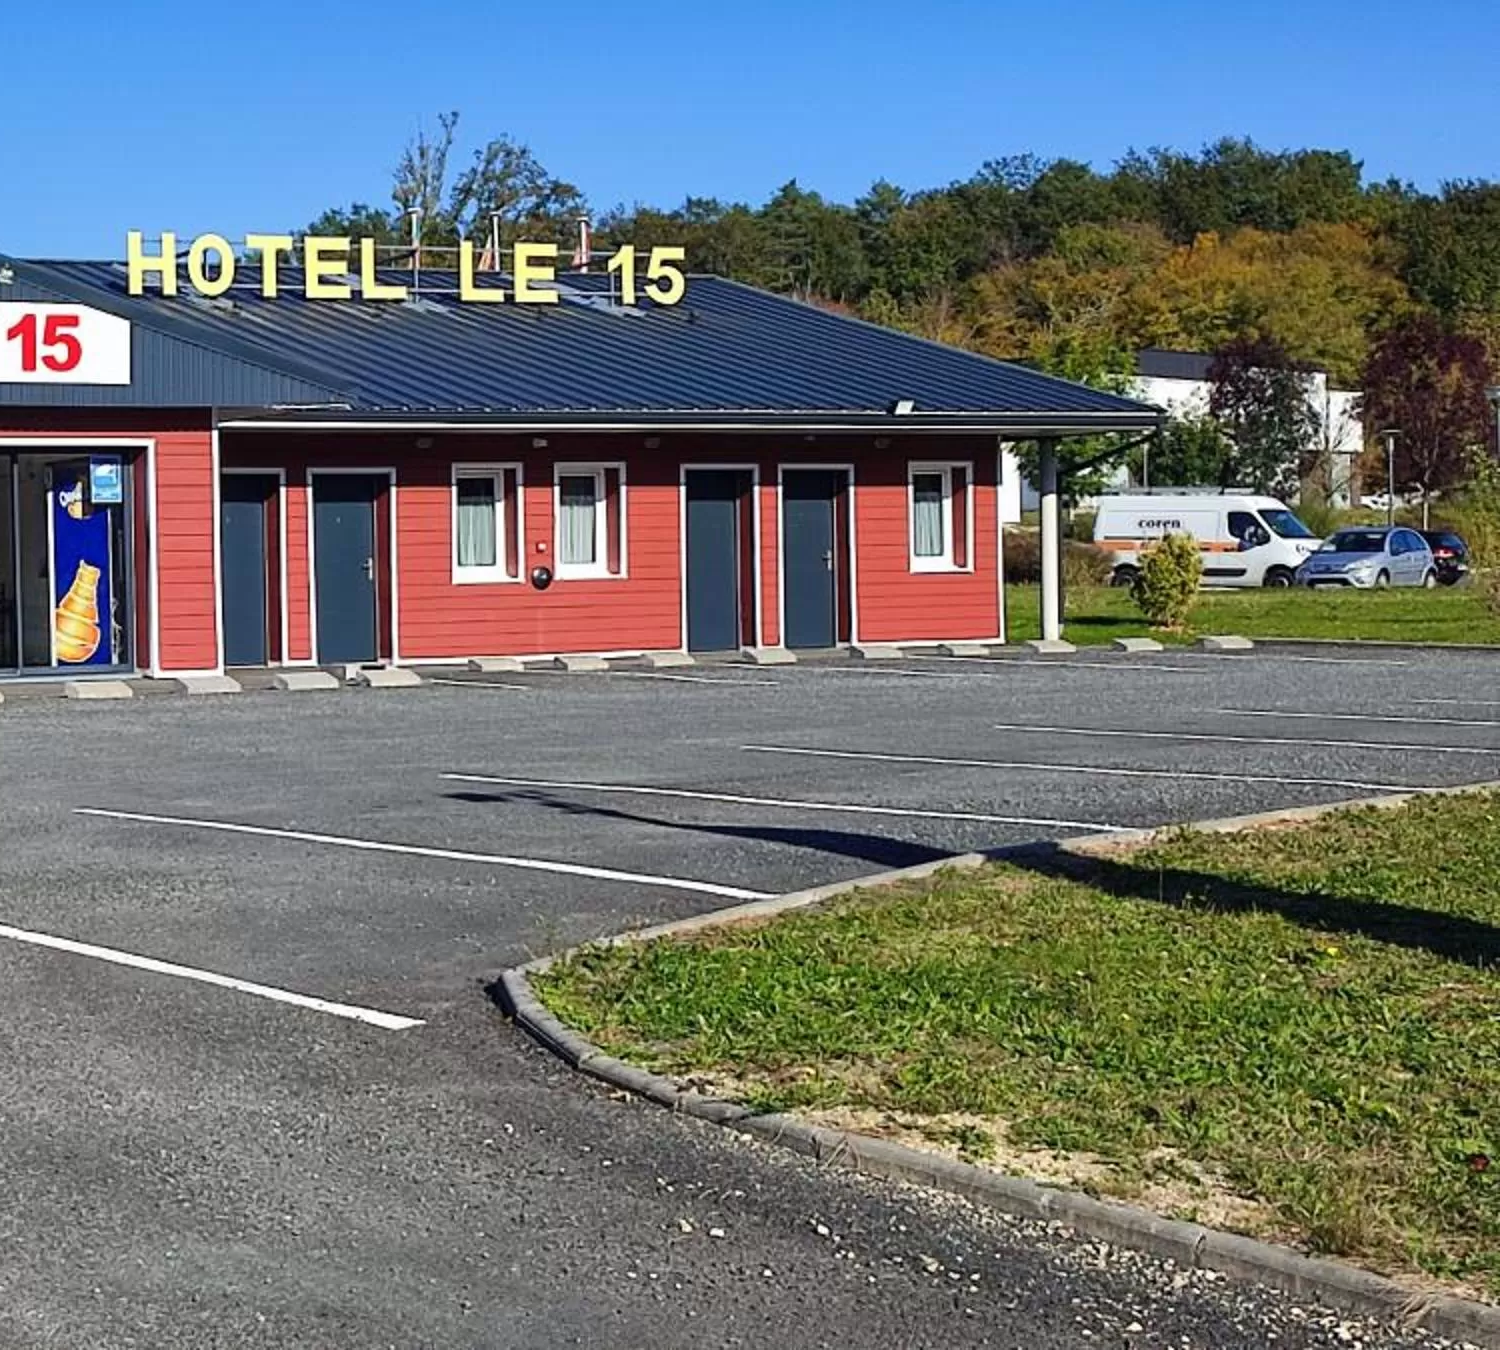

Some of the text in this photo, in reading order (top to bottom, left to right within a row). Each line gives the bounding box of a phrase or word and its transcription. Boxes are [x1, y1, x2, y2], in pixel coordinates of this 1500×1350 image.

[127, 231, 687, 306] HOTEL LE 15
[7, 313, 83, 373] 15
